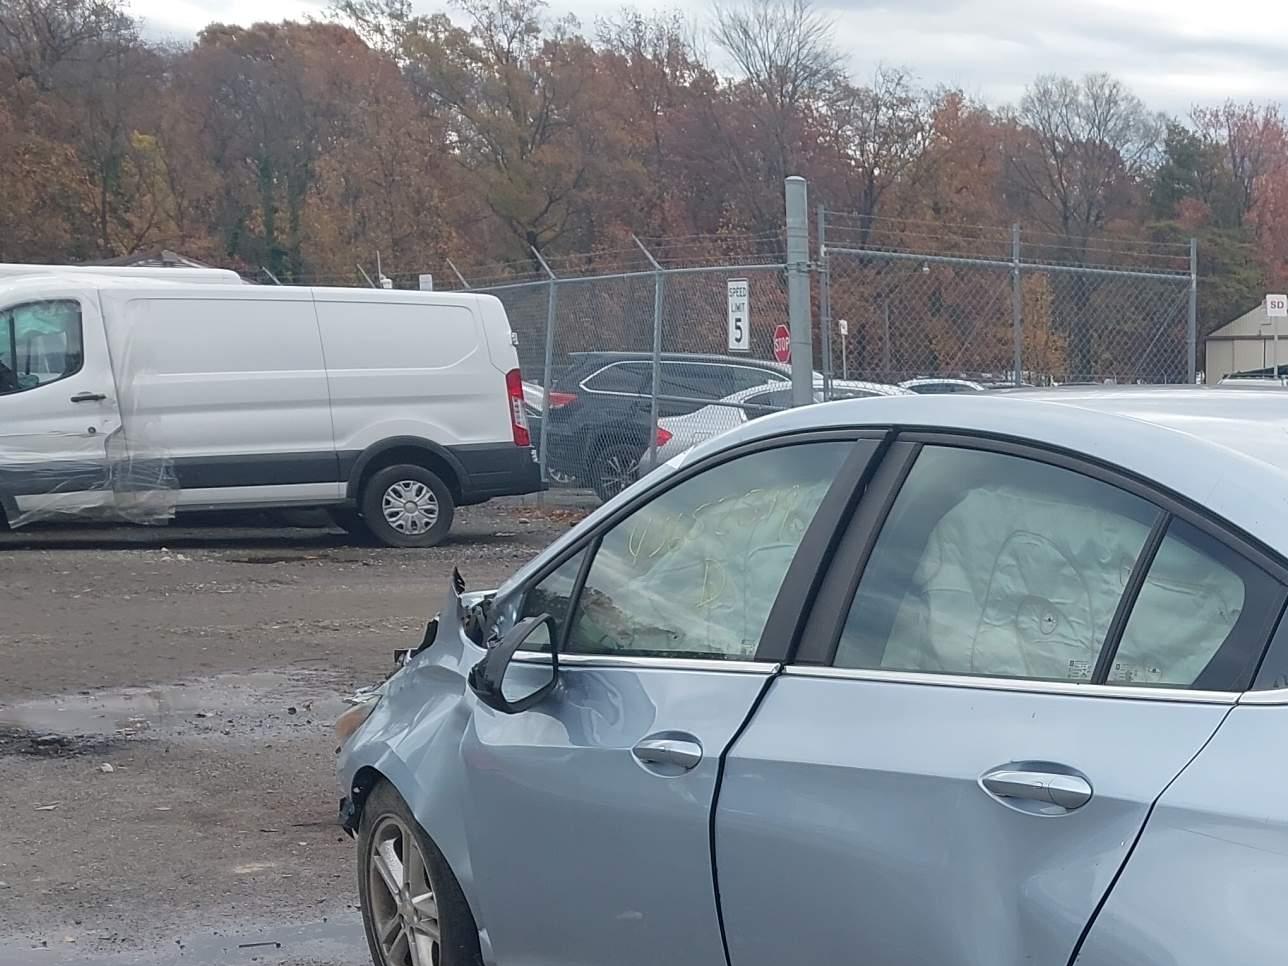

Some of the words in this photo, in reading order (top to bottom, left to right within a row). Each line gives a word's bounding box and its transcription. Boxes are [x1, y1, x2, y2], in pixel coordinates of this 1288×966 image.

[729, 286, 747, 298] SPEED
[731, 302, 745, 313] LIMIT
[1270, 300, 1284, 310] SD
[734, 317, 743, 344] 5
[775, 336, 789, 352] STOP
